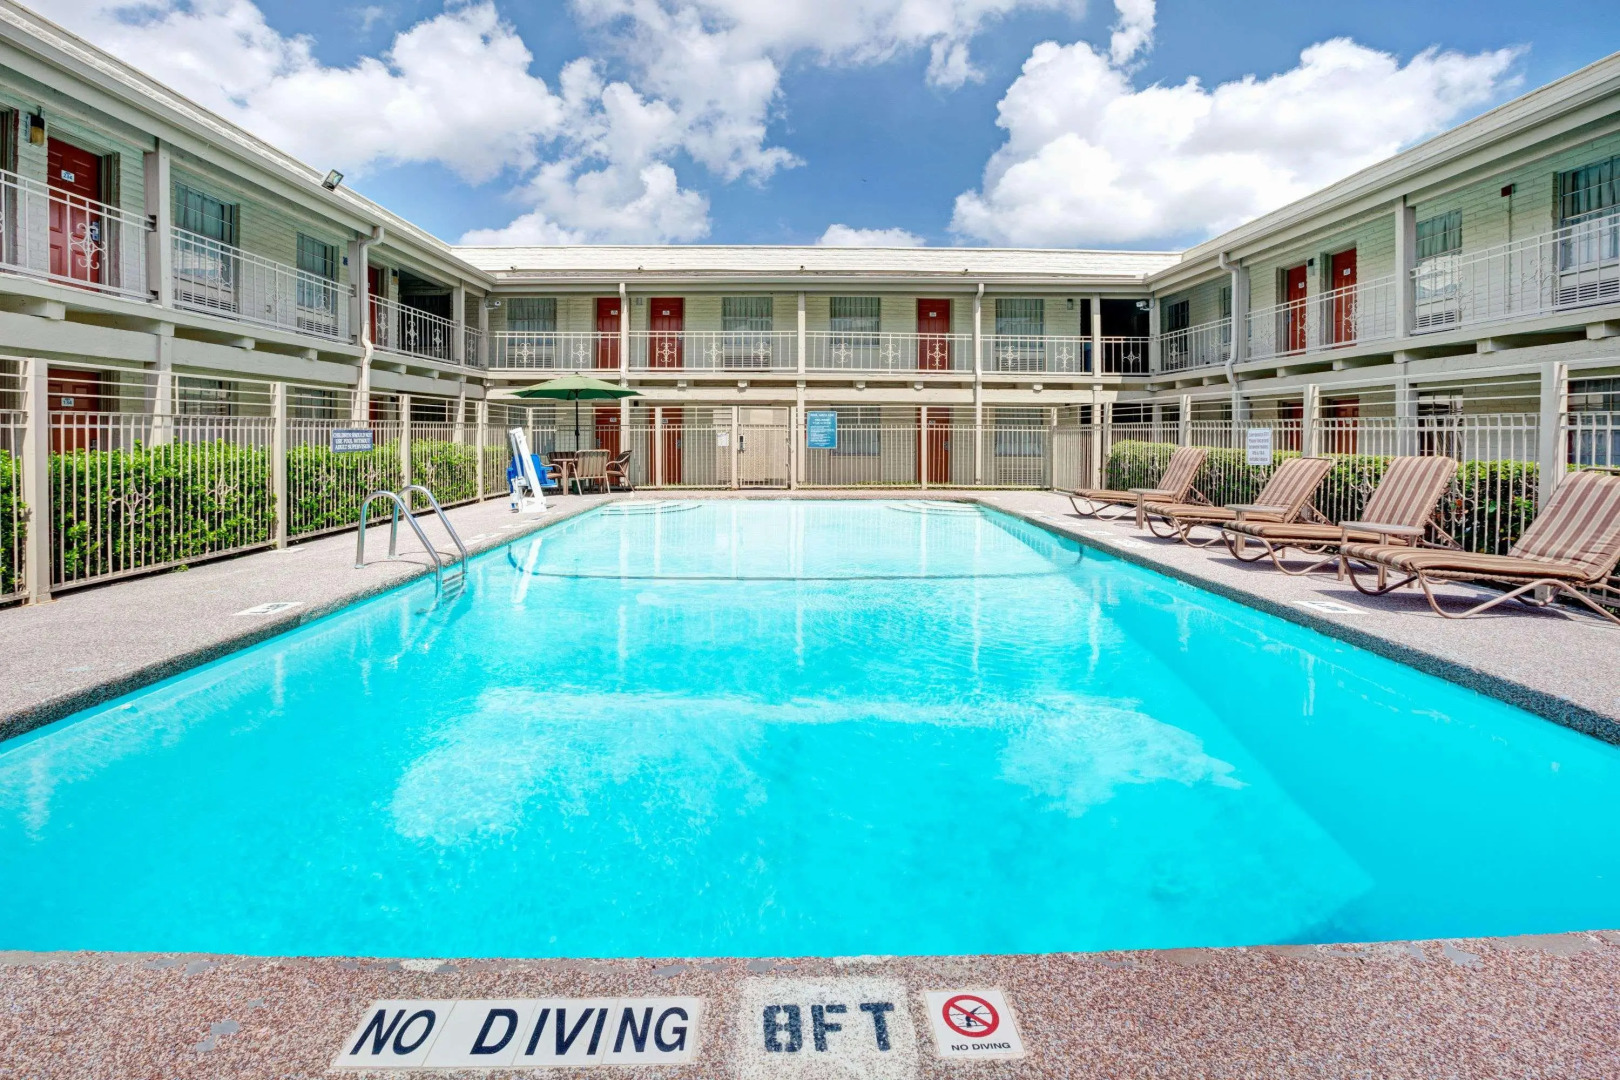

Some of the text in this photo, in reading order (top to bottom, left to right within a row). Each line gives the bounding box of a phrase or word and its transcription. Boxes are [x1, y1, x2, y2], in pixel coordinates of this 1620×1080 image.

[349, 1006, 689, 1056] NO DIVING
[762, 1002, 895, 1053] 8FT
[971, 1042, 1011, 1050] DIVING
